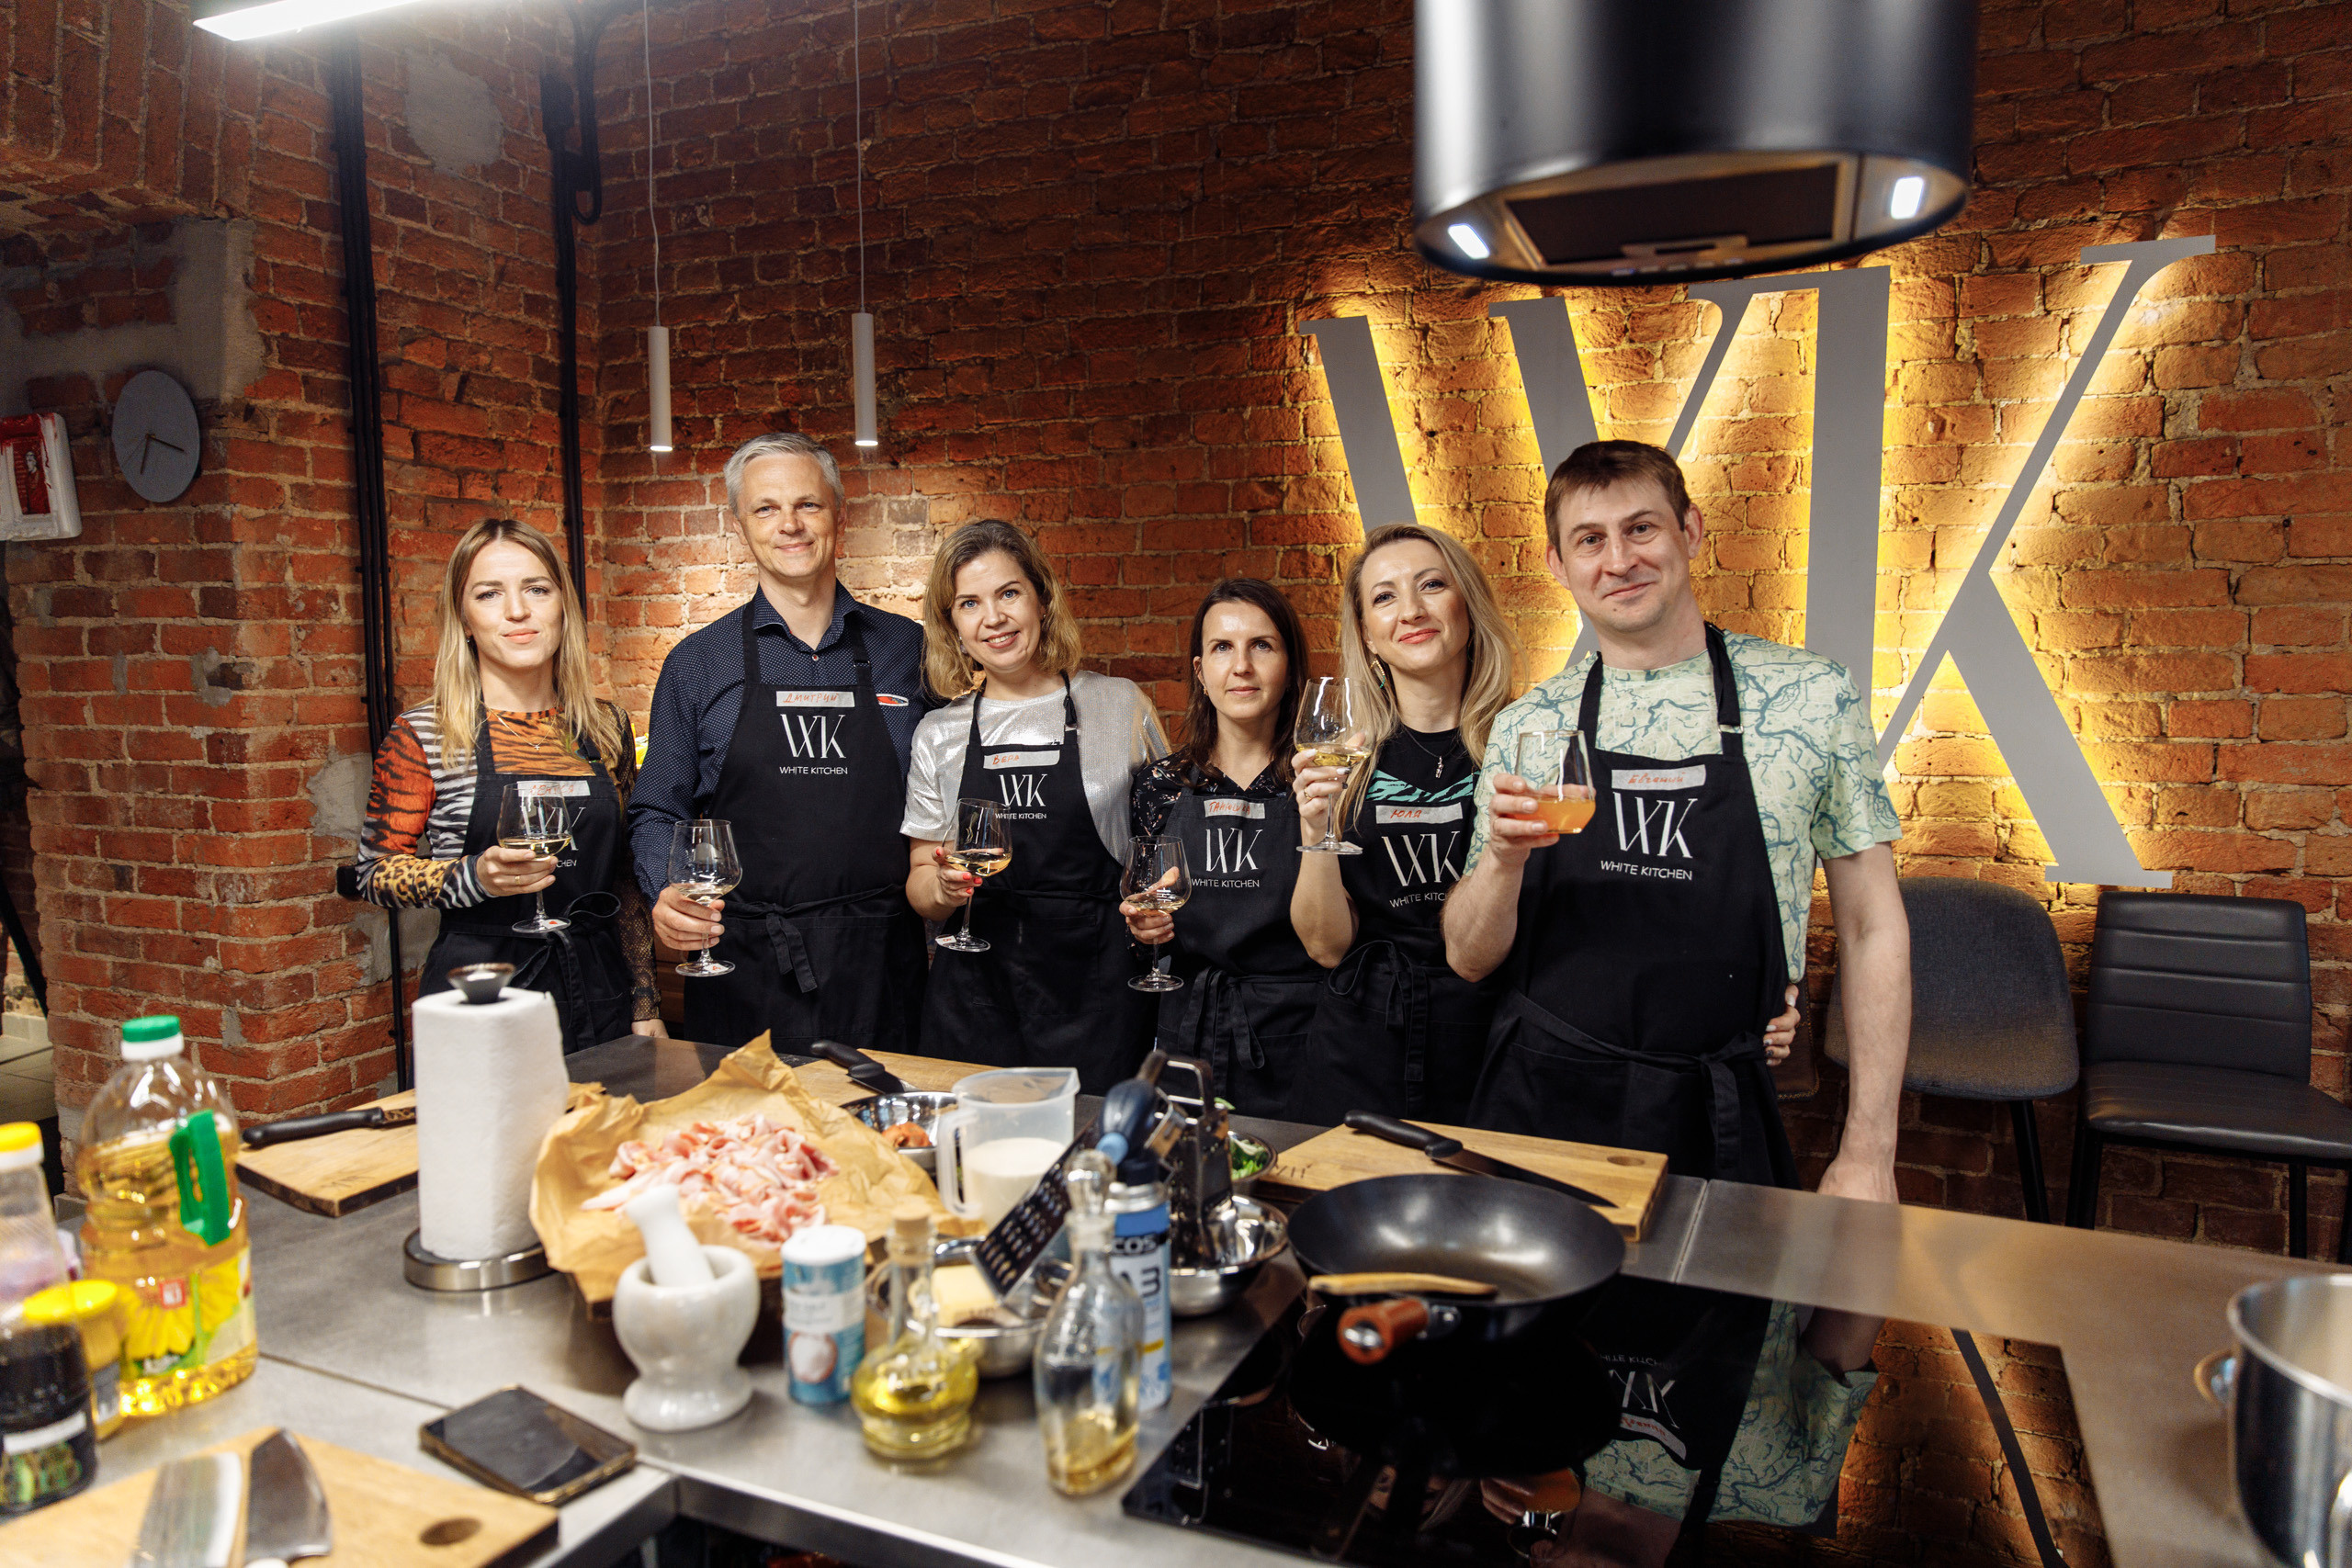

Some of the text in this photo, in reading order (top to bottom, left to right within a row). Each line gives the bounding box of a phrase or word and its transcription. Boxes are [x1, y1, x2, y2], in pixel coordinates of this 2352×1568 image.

[783, 693, 840, 704] ДМИТРИЙ
[780, 714, 846, 759] WK
[992, 754, 1020, 765] ВЕРА
[779, 766, 848, 775] WHITE KITCHEN
[999, 773, 1047, 807] WK
[1390, 809, 1421, 819] ЮЛЯ
[1612, 792, 1698, 859] WK
[1205, 827, 1263, 874] WK
[1381, 830, 1460, 886] WK
[556, 859, 577, 868] CHEN
[1600, 860, 1693, 881] WHITE KITCHEN
[1191, 878, 1260, 888] WHITE KITCHEN
[1389, 891, 1448, 908] WHITE KITC
